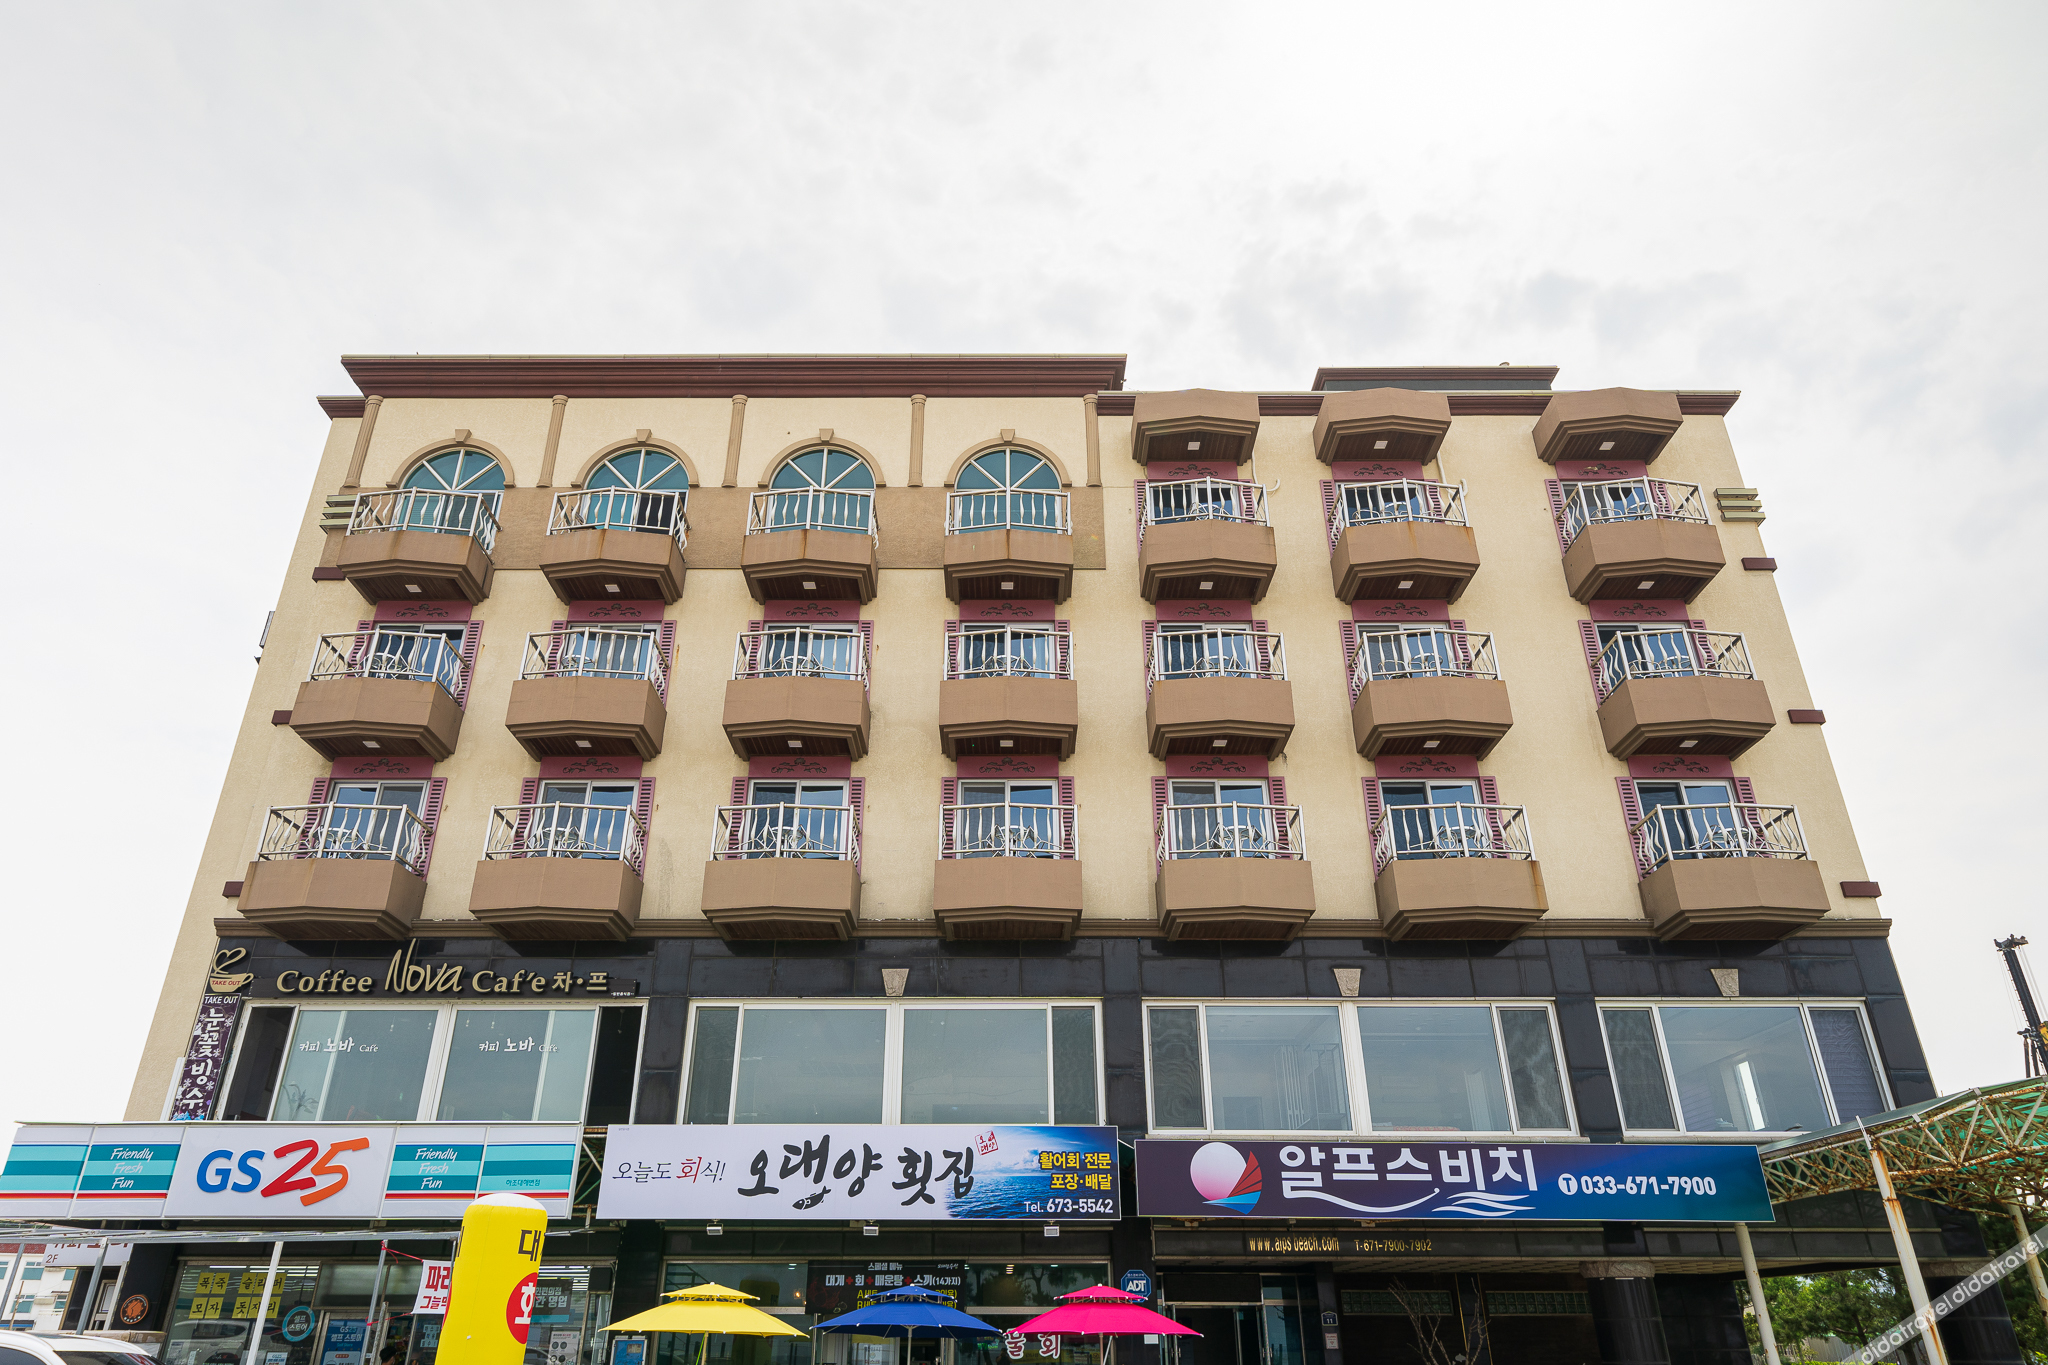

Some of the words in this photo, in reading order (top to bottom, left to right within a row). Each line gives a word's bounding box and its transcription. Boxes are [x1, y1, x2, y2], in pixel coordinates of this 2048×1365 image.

[276, 969, 373, 993] Coffee
[384, 938, 464, 993] Nova
[204, 996, 222, 1004] TAKE
[223, 995, 239, 1004] OUT
[299, 1041, 320, 1052] 커피
[323, 1037, 355, 1053] 노바
[478, 1041, 500, 1052] 커피
[503, 1036, 535, 1052] 노바
[110, 1147, 153, 1162] Friendly
[415, 1147, 458, 1162] Friendly
[1039, 1152, 1080, 1169] 활어회
[1084, 1152, 1112, 1169] 전문
[112, 1162, 144, 1174] Fresh
[196, 1137, 370, 1207] GS25
[418, 1162, 449, 1175] Fresh
[612, 1161, 672, 1183] 오늘도
[675, 1156, 726, 1184] 회식!
[737, 1134, 883, 1197] 오대양
[891, 1146, 974, 1206] 횟집
[1278, 1145, 1539, 1199] 알프스비치
[111, 1177, 134, 1189] Fun
[420, 1177, 443, 1190] Fun
[1581, 1175, 1717, 1196] 033-671-7900
[1024, 1201, 1044, 1213] Tel.
[1046, 1199, 1114, 1213] 673-5542
[45, 1254, 59, 1264] 2F
[867, 1262, 888, 1271] 스페셜
[889, 1262, 903, 1270] 메뉴
[199, 1277, 227, 1290] 폭죽
[825, 1274, 845, 1286] 대게
[855, 1274, 865, 1286] 회
[874, 1274, 904, 1286] 매운탕
[1126, 1280, 1146, 1292] ADT
[192, 1302, 220, 1314] 모자
[548, 1295, 568, 1308] 영업
